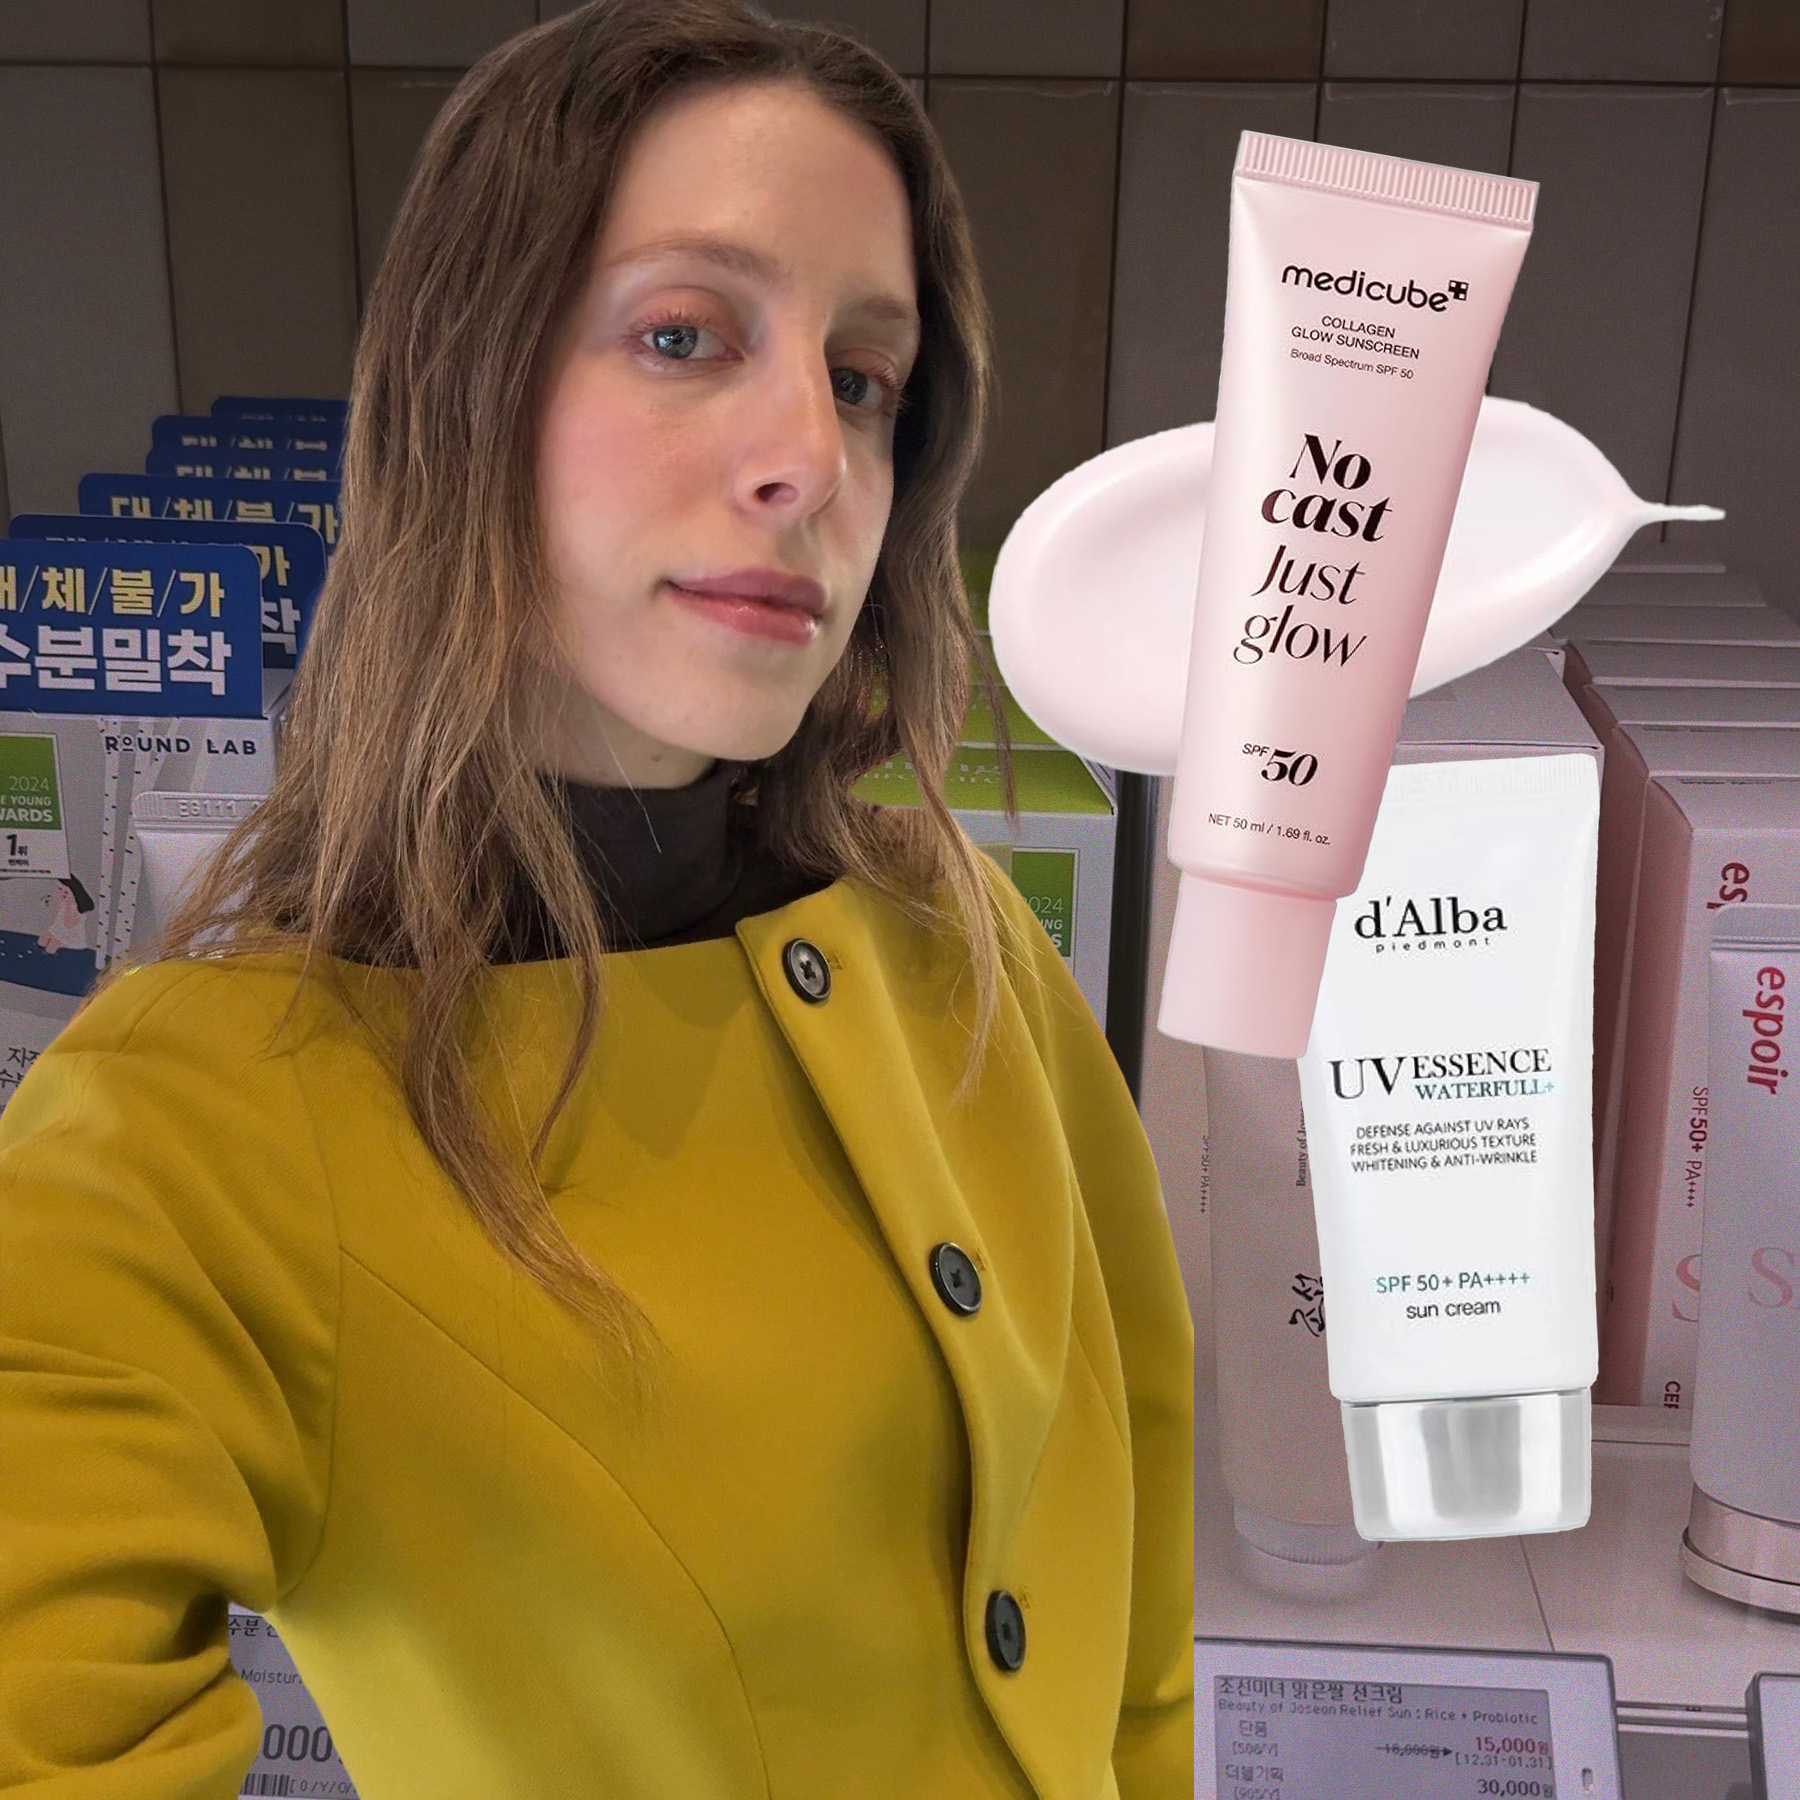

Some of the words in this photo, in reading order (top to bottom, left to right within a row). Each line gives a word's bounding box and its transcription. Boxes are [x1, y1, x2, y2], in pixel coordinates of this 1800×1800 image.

[1281, 264, 1449, 312] medicube
[1321, 315, 1396, 339] COLLAGEN
[1291, 326, 1333, 344] GLOW
[1336, 333, 1420, 360] SUNSCREEN
[1290, 348, 1322, 363] Broad
[1324, 353, 1374, 373] Spectrum
[1375, 364, 1399, 376] SPF
[1399, 368, 1414, 380] 50
[1289, 433, 1372, 490] No
[1261, 487, 1393, 542] cast
[1250, 545, 1366, 604] Just
[1233, 605, 1368, 666] glow
[206, 739, 257, 755] LAB
[1241, 742, 1270, 757] SPF
[1261, 748, 1319, 786] 50
[9, 775, 50, 792] 2024
[10, 795, 52, 807] YOUNG
[1208, 813, 1232, 826] NET
[1232, 817, 1248, 830] 50
[1250, 822, 1265, 833] ml
[1276, 826, 1301, 839] 1.69
[1303, 830, 1312, 842] fl.
[1353, 895, 1508, 939] d'Alba
[1375, 936, 1491, 953] piedmont
[1742, 966, 1788, 1096] espoir
[1328, 1055, 1404, 1100] UV
[1412, 1047, 1552, 1080] ESSENCE
[1415, 1079, 1554, 1101] WATERFULL+
[1356, 1123, 1411, 1140] DEFENSE
[1414, 1120, 1471, 1136] AGAINST
[1474, 1119, 1494, 1132] UV
[1497, 1117, 1530, 1131] RAYS
[1350, 1143, 1389, 1156] FRESH
[1392, 1141, 1402, 1153] &
[1404, 1136, 1478, 1152] LUXURIOUS
[1481, 1133, 1537, 1148] TEXTURE
[1351, 1157, 1428, 1172] WHITENING
[1430, 1156, 1441, 1168] &
[1444, 1150, 1538, 1167] ANTI-WRINKLE
[1376, 1275, 1411, 1294] SPF
[1417, 1274, 1453, 1292] 50+
[1458, 1272, 1531, 1289] PA++++
[1406, 1302, 1439, 1319] sun
[1444, 1300, 1502, 1317] cream
[241, 1669, 303, 1684] Moistur
[1220, 1678, 1285, 1698] 조선미녀
[1353, 1684, 1403, 1704] 선크림
[1218, 1699, 1265, 1713] Beauty
[1270, 1702, 1284, 1713] of
[1291, 1702, 1337, 1715] Joseon
[1340, 1704, 1382, 1717] Relief
[1387, 1707, 1412, 1719] Sun
[1425, 1708, 1456, 1721] Rice
[1473, 1710, 1538, 1725] Probiotic
